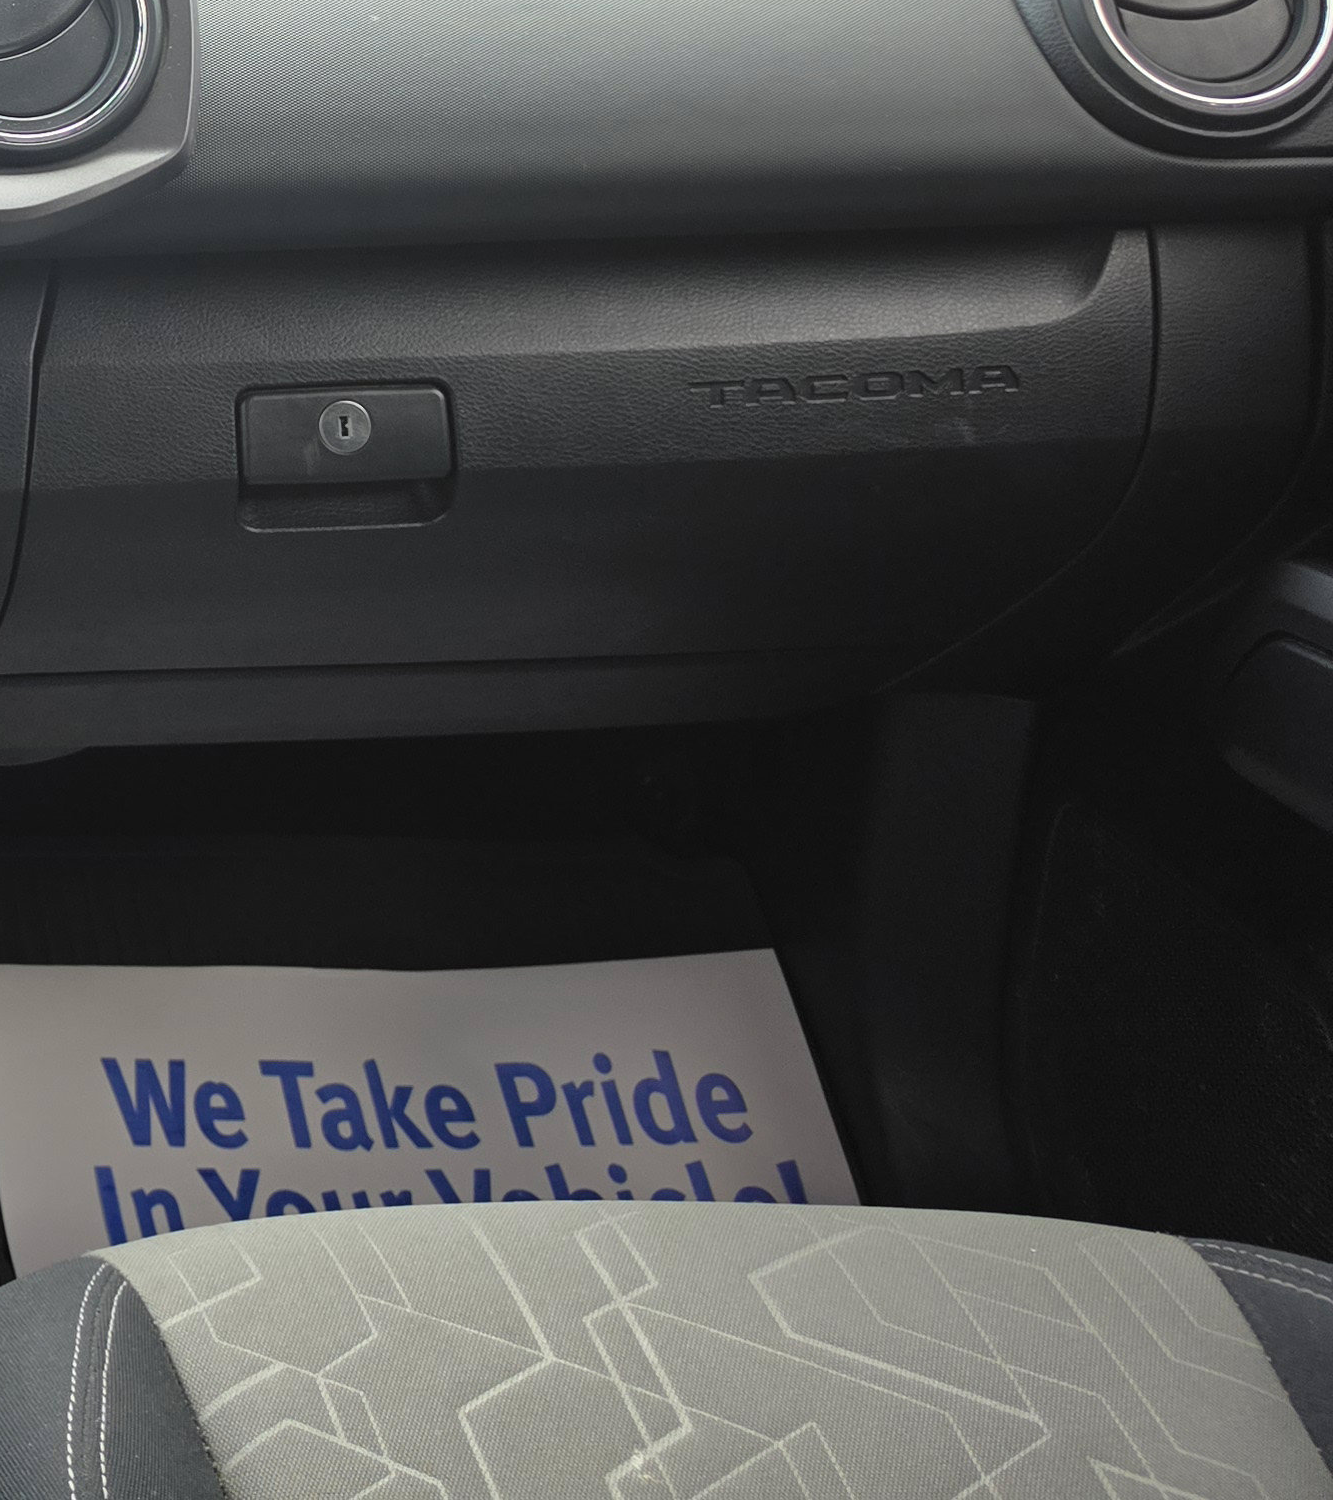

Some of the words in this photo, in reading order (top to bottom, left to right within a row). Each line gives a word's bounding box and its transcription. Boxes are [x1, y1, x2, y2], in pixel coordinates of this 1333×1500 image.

[687, 364, 1022, 409] TACOMA
[100, 1057, 250, 1150] We
[259, 1057, 481, 1153] Take
[494, 1049, 754, 1147] Pride
